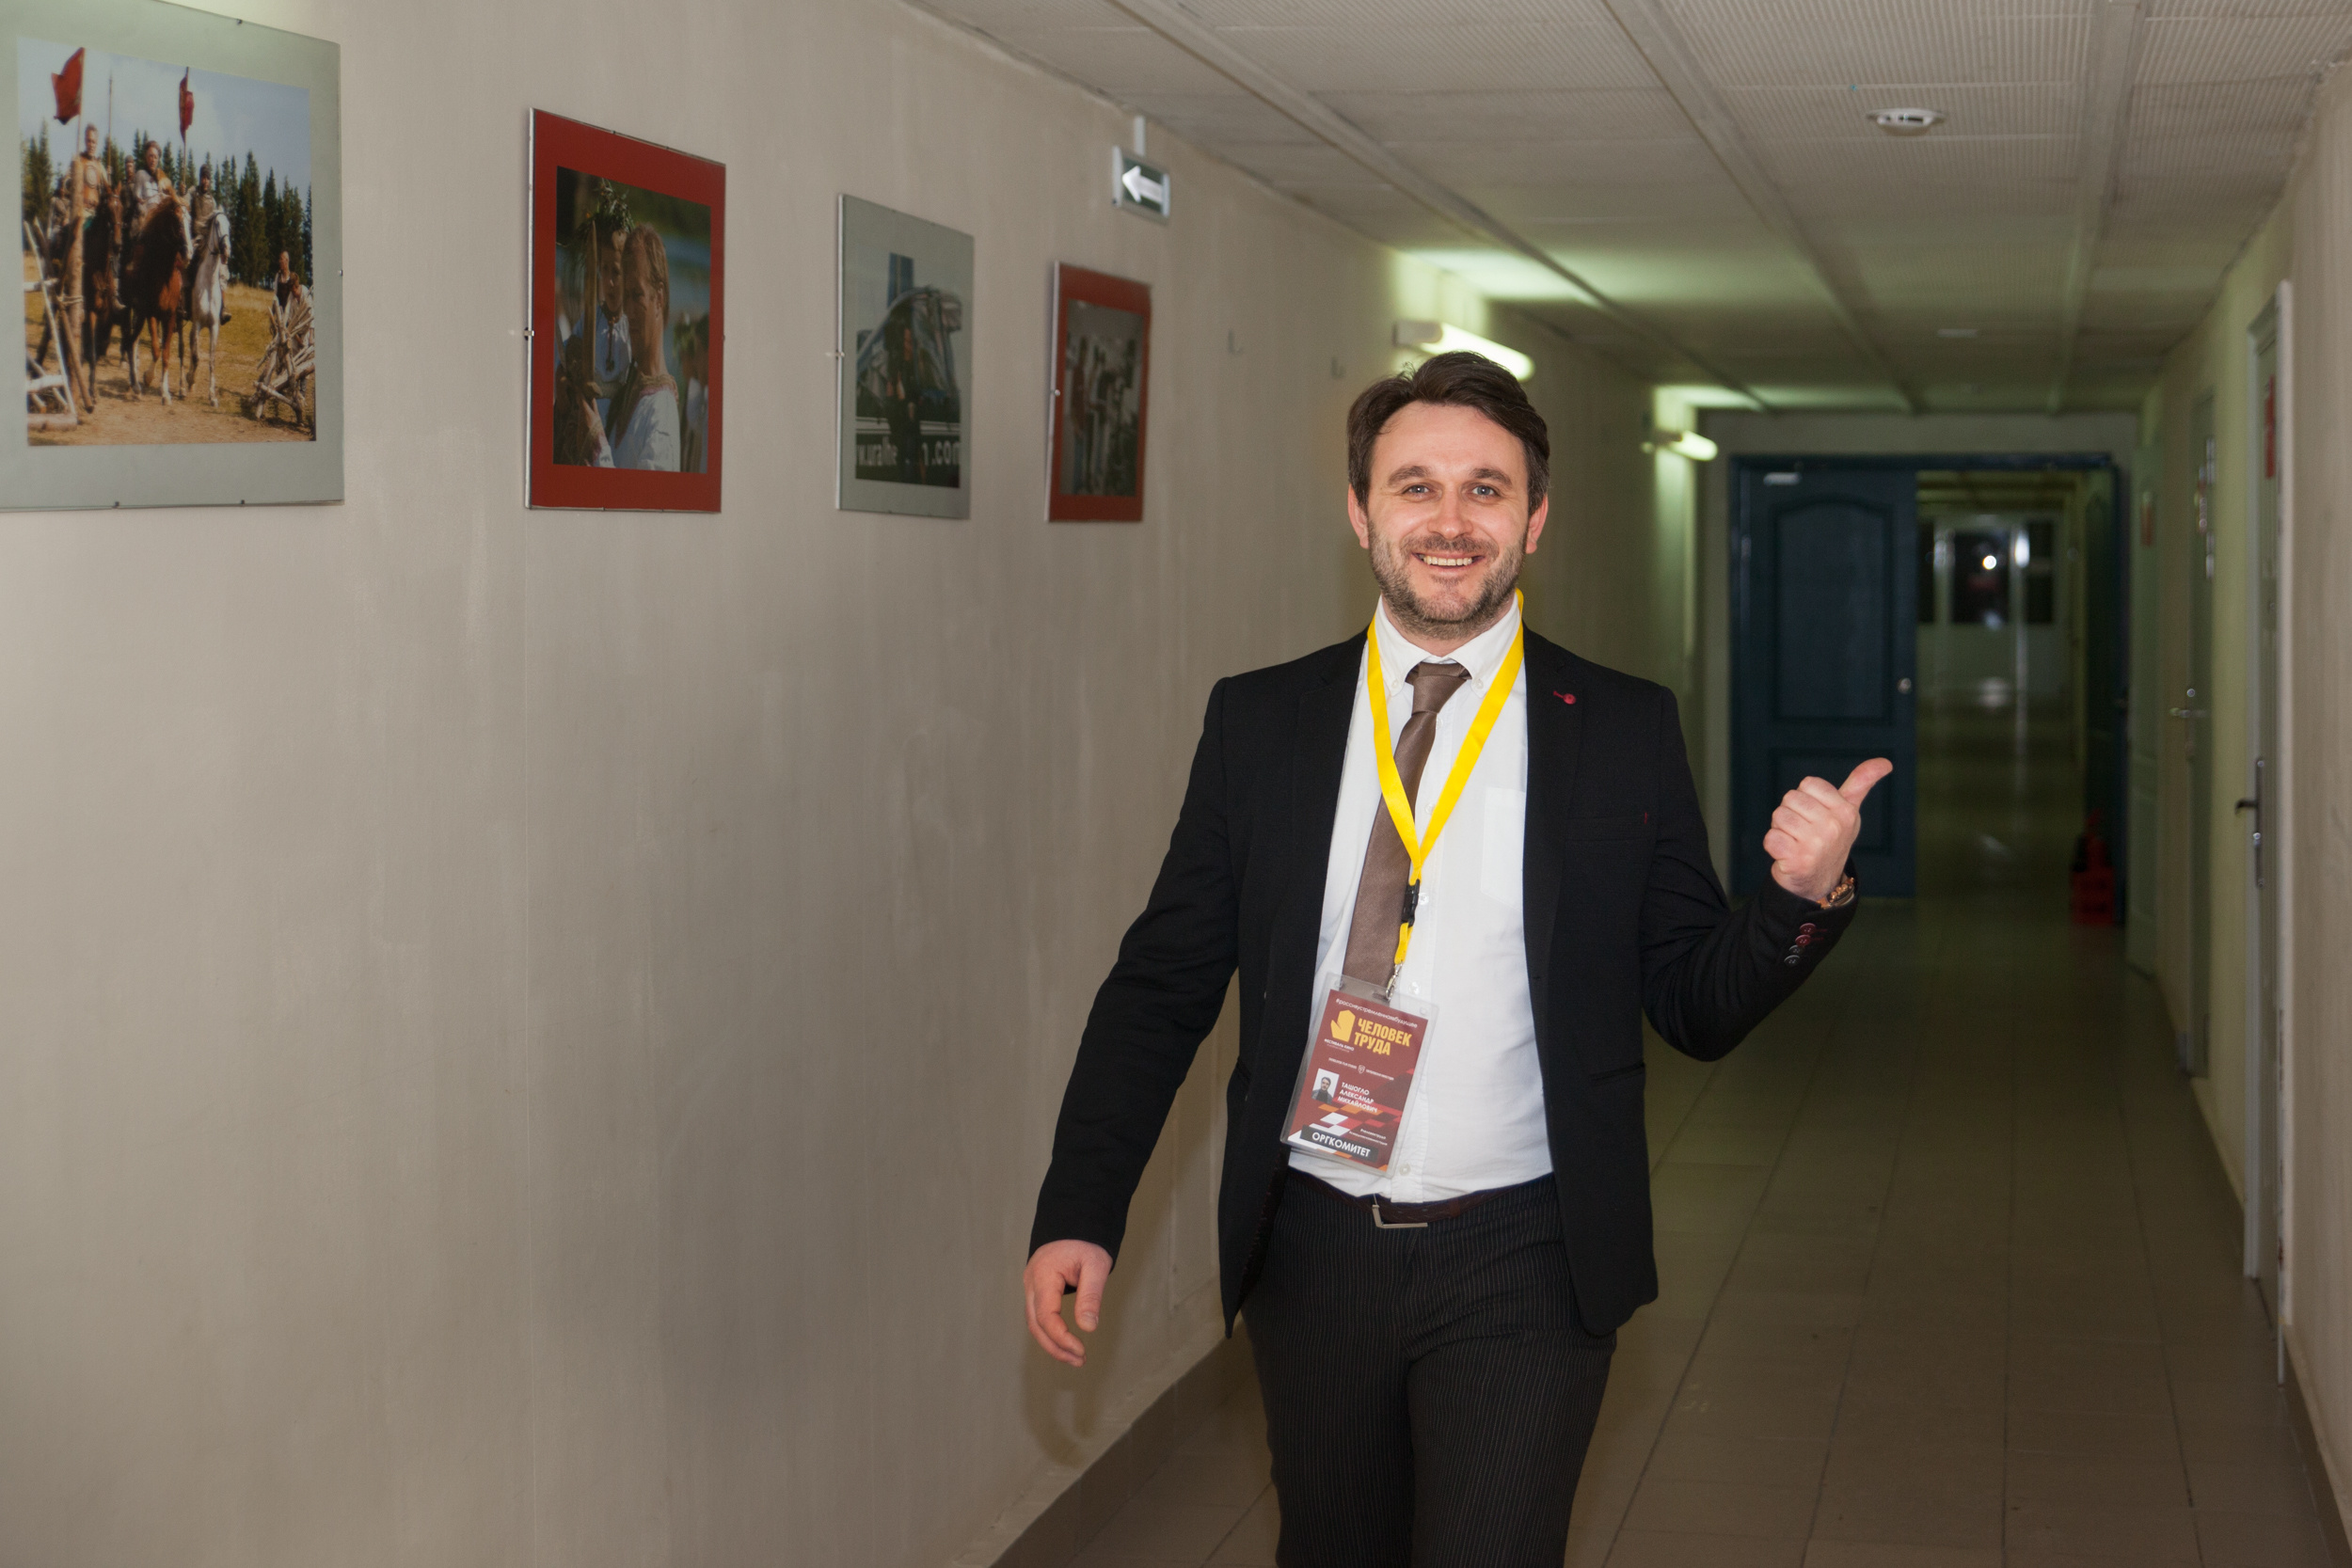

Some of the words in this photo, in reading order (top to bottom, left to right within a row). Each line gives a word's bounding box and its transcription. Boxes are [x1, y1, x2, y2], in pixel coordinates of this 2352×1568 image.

[1358, 1018, 1413, 1047] ЧЕЛОВЕК
[1354, 1031, 1391, 1056] ТРУДА
[1339, 1089, 1375, 1103] АЛЕКСАНДР
[1341, 1082, 1370, 1096] ТАШОГЛО
[1338, 1096, 1377, 1113] МИХАЙЛОВИЧ
[1311, 1132, 1371, 1158] ОРГКОМИТЕТ
